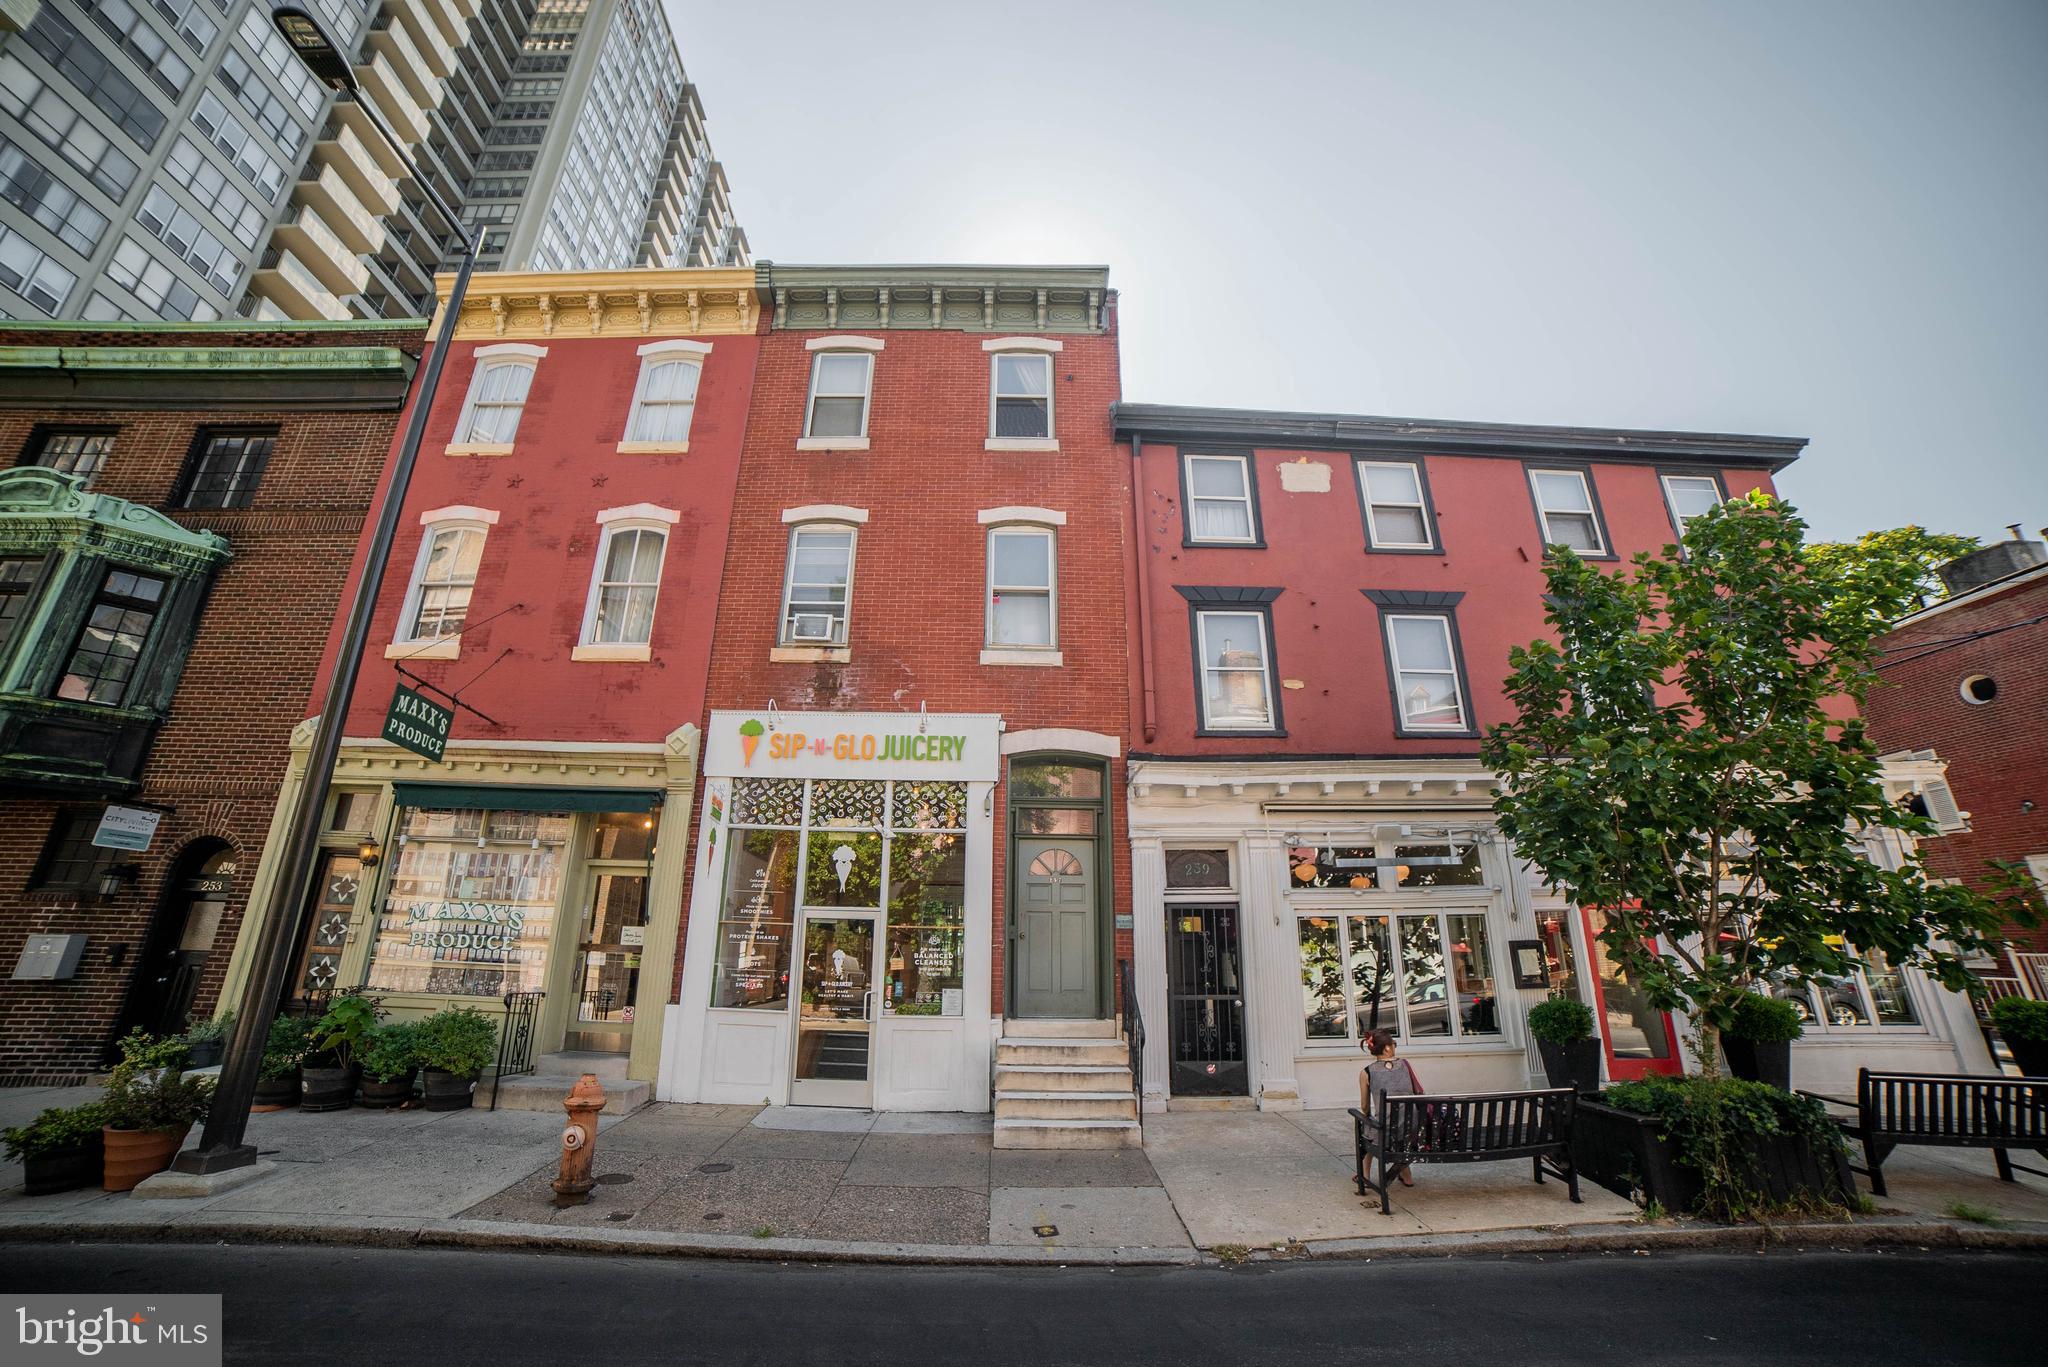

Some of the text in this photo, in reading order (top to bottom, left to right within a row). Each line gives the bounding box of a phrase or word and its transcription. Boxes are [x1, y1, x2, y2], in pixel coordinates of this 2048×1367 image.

[395, 695, 448, 735] MAXX'S
[388, 718, 443, 754] PRODUCE
[877, 734, 967, 762] JUICERY
[200, 880, 223, 891] 253
[404, 901, 525, 931] MAXX'S
[408, 931, 515, 951] PRODUCE
